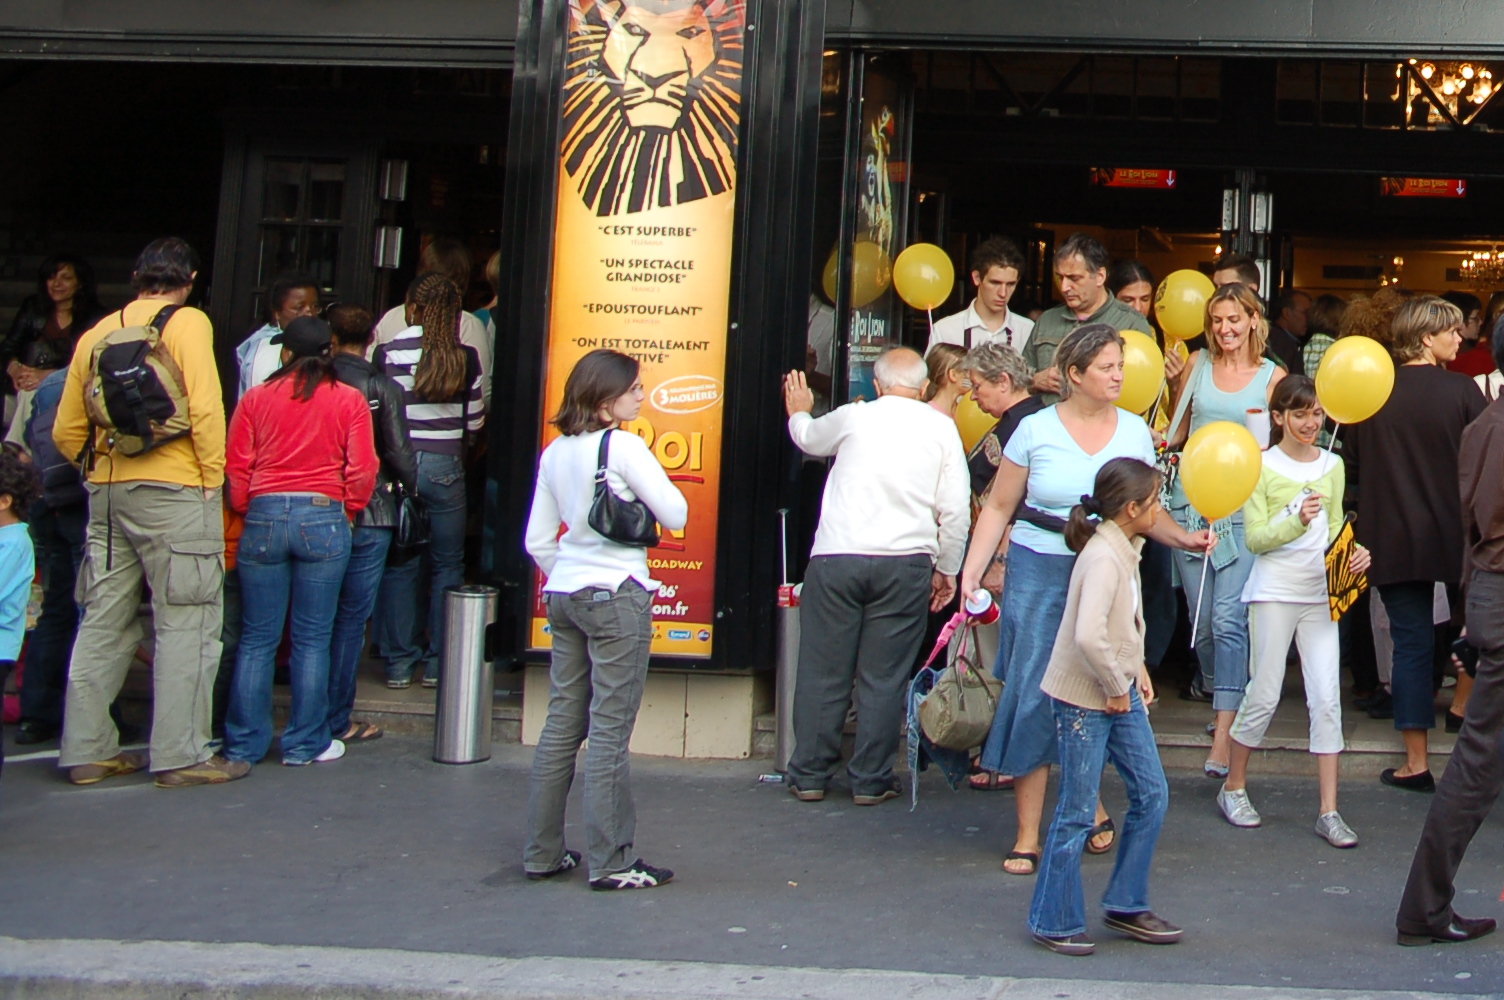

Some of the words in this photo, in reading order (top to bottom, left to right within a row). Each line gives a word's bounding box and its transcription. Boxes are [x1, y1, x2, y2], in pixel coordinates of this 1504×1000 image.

[628, 259, 694, 270] SPECTACLE
[601, 338, 622, 349] EST
[624, 339, 710, 351] TOTALEMENT
[659, 389, 669, 405] 3
[670, 390, 718, 404] MOLIÈRES
[646, 559, 703, 570] ROADWAY
